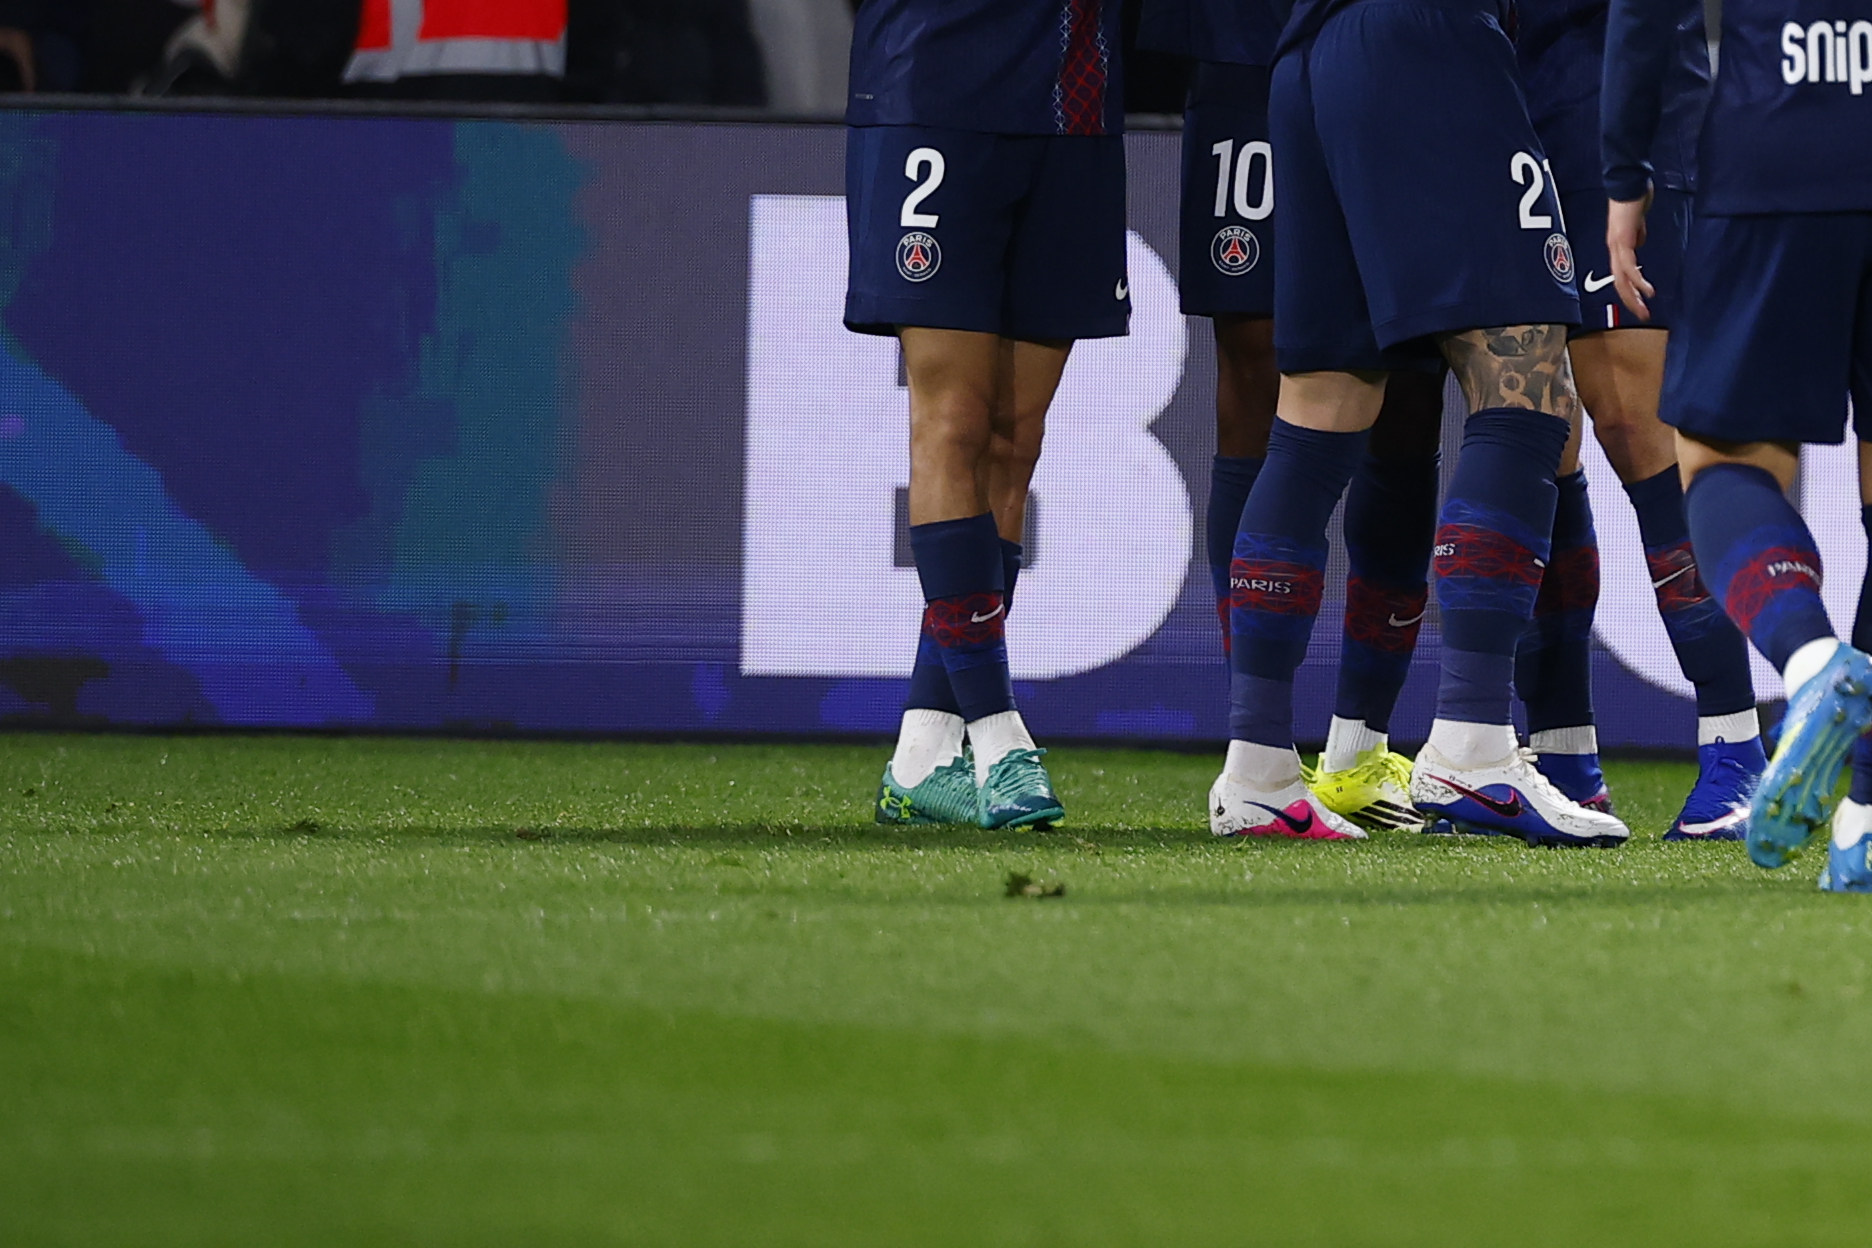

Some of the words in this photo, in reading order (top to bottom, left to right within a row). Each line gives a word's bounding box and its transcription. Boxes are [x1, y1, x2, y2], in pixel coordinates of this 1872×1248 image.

[900, 146, 946, 230] 2
[1211, 138, 1275, 222] 10
[1510, 150, 1567, 235] 21
[903, 234, 934, 248] PARIS
[1219, 228, 1251, 242] PARIS
[1229, 577, 1292, 594] PARIS
